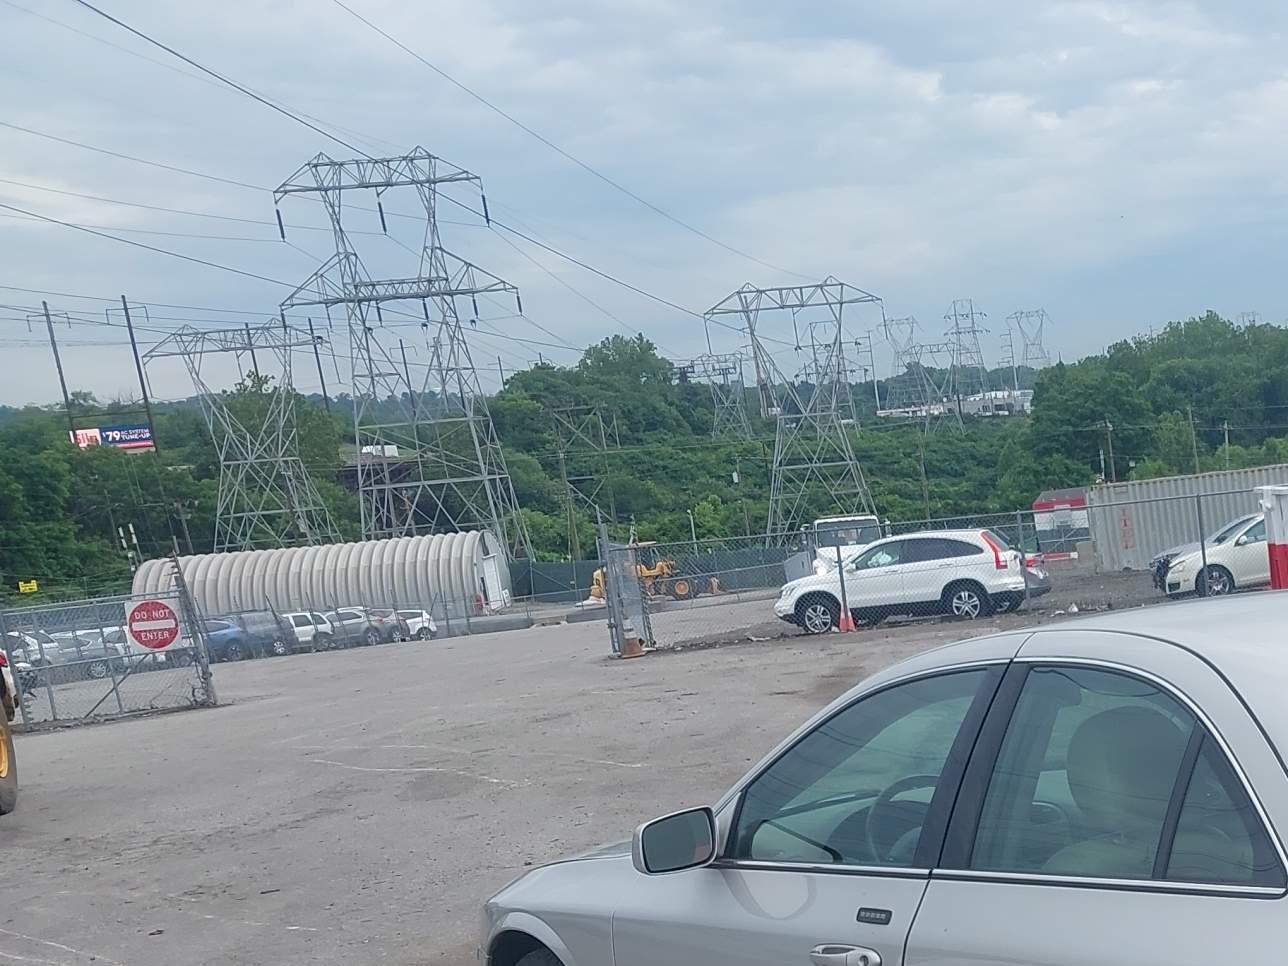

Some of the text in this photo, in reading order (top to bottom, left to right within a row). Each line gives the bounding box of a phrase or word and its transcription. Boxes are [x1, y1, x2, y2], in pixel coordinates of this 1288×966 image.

[102, 430, 120, 441] $79
[121, 432, 151, 440] TUNE-UP
[134, 609, 170, 619] DO NOT
[141, 631, 169, 640] ENTER
